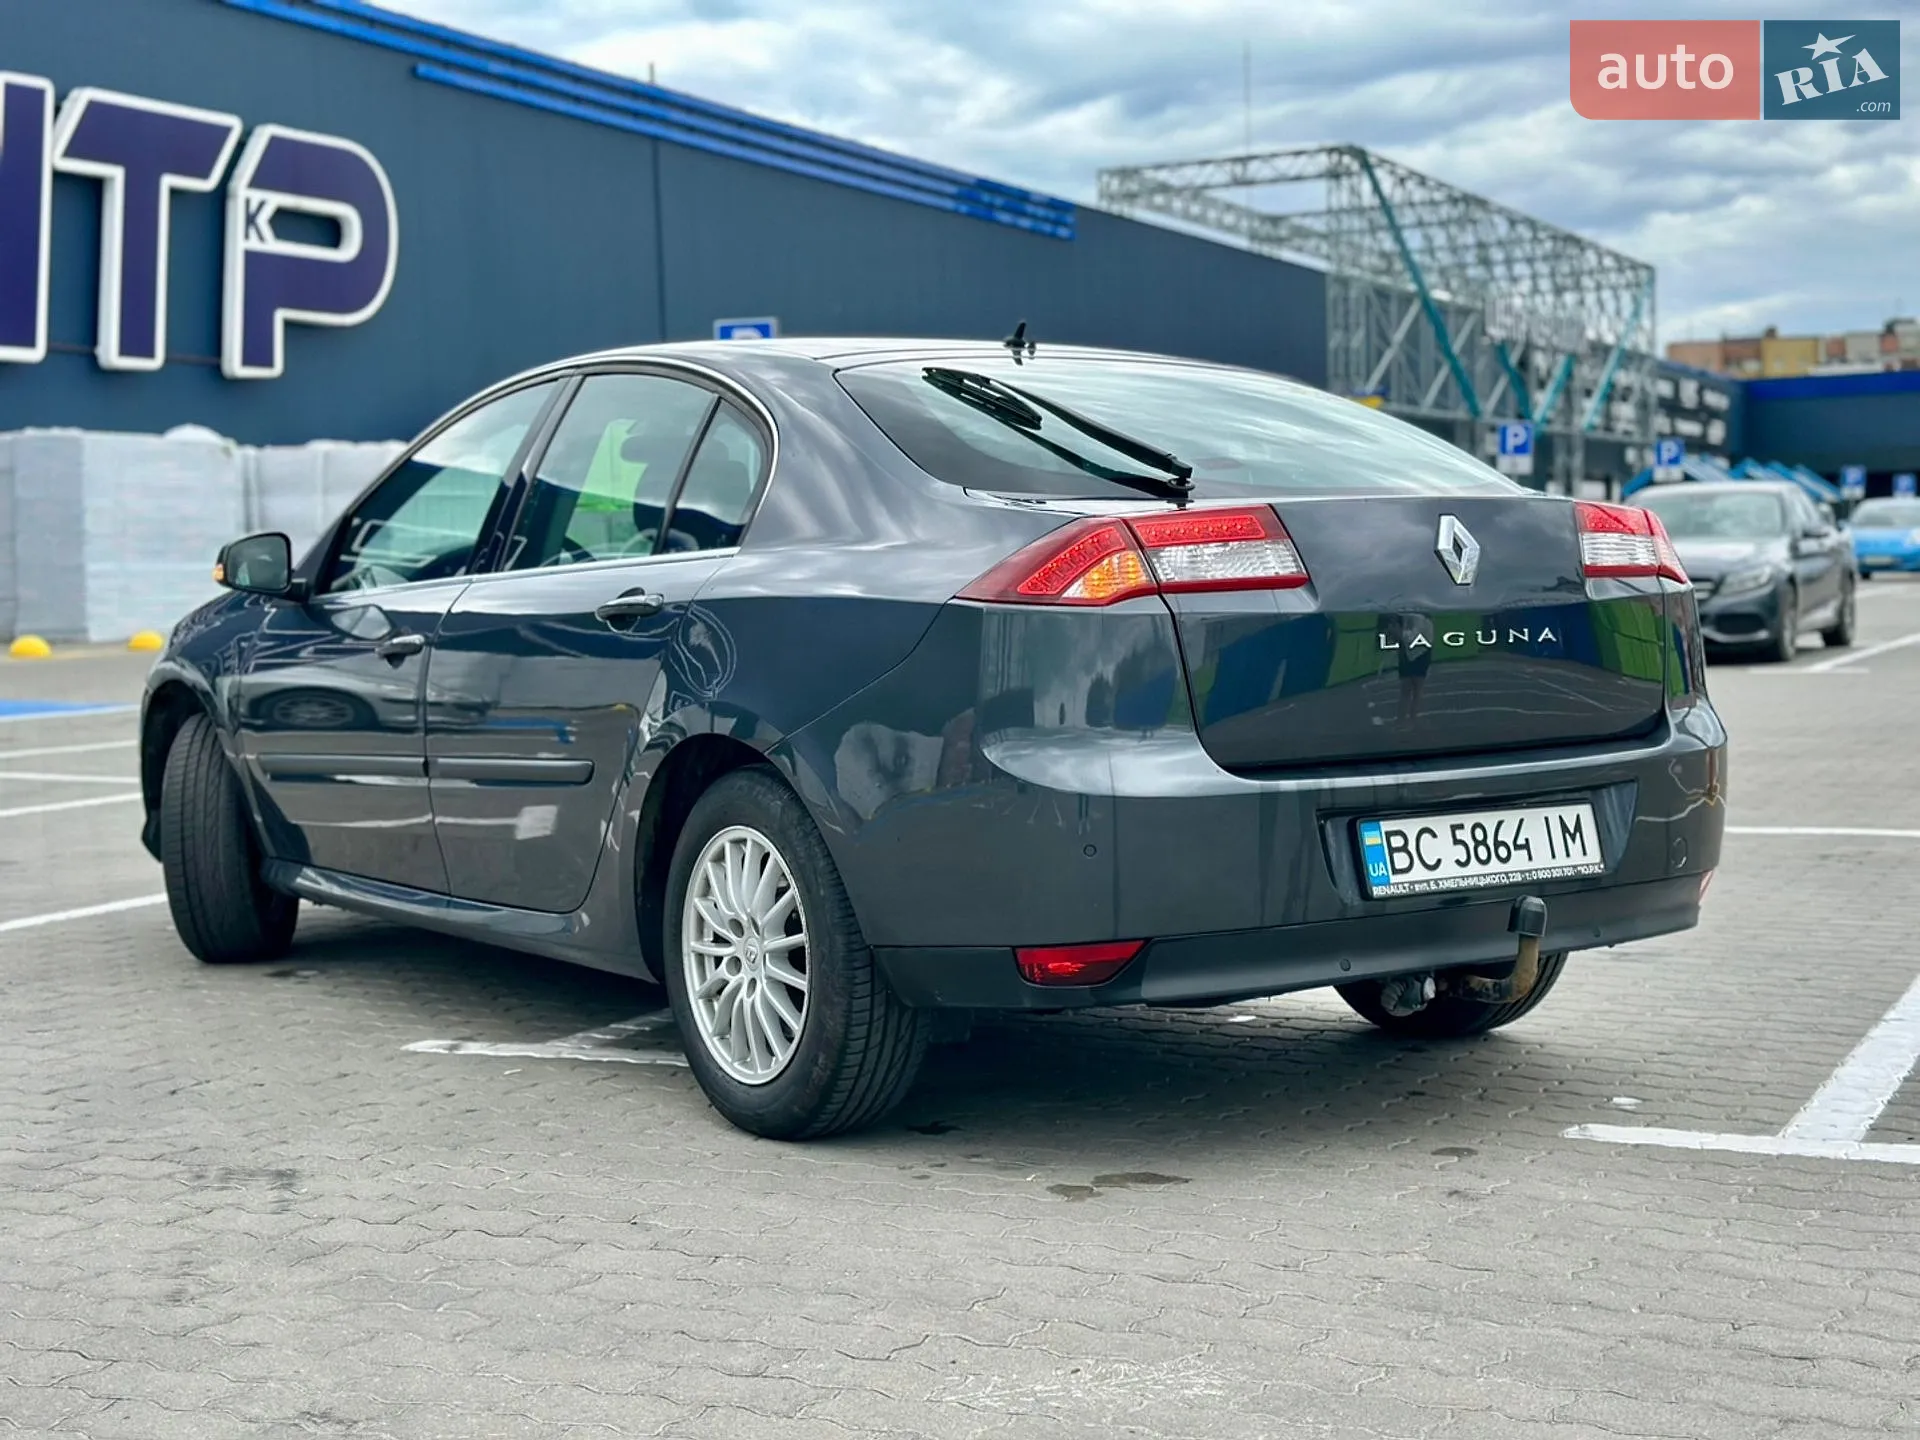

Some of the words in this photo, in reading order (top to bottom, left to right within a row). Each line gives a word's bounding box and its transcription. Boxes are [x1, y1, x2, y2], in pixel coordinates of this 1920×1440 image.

[1506, 425, 1528, 454] P
[1378, 627, 1557, 650] LAGUNA
[1385, 826, 1442, 875] BC
[1450, 818, 1533, 868] 5864
[1544, 813, 1587, 859] IM
[1370, 863, 1387, 876] UA
[1373, 883, 1410, 897] RENAULT
